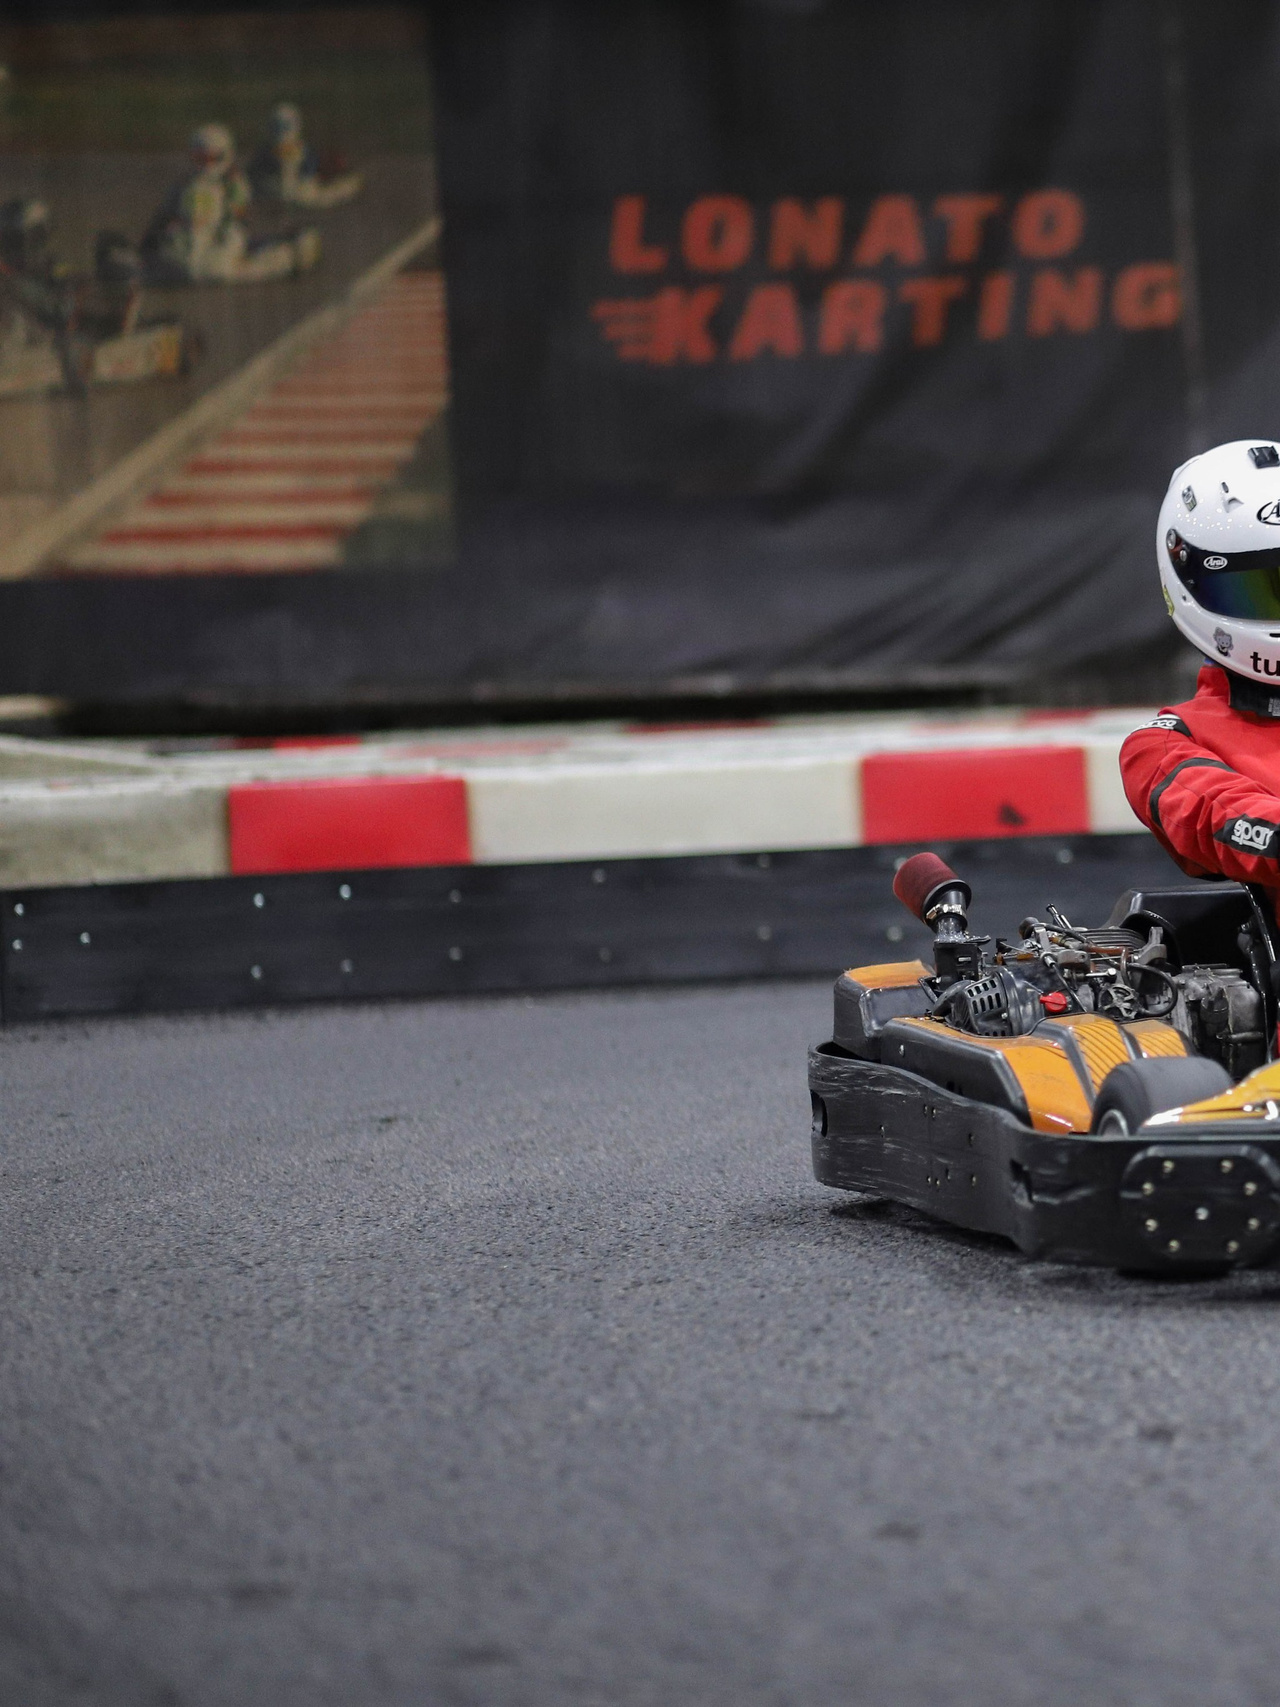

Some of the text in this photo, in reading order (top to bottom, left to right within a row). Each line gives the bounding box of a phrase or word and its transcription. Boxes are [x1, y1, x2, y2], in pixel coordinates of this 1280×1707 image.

[609, 190, 1085, 275] LONATO
[642, 261, 1180, 365] KARTING
[1231, 819, 1274, 850] spar
